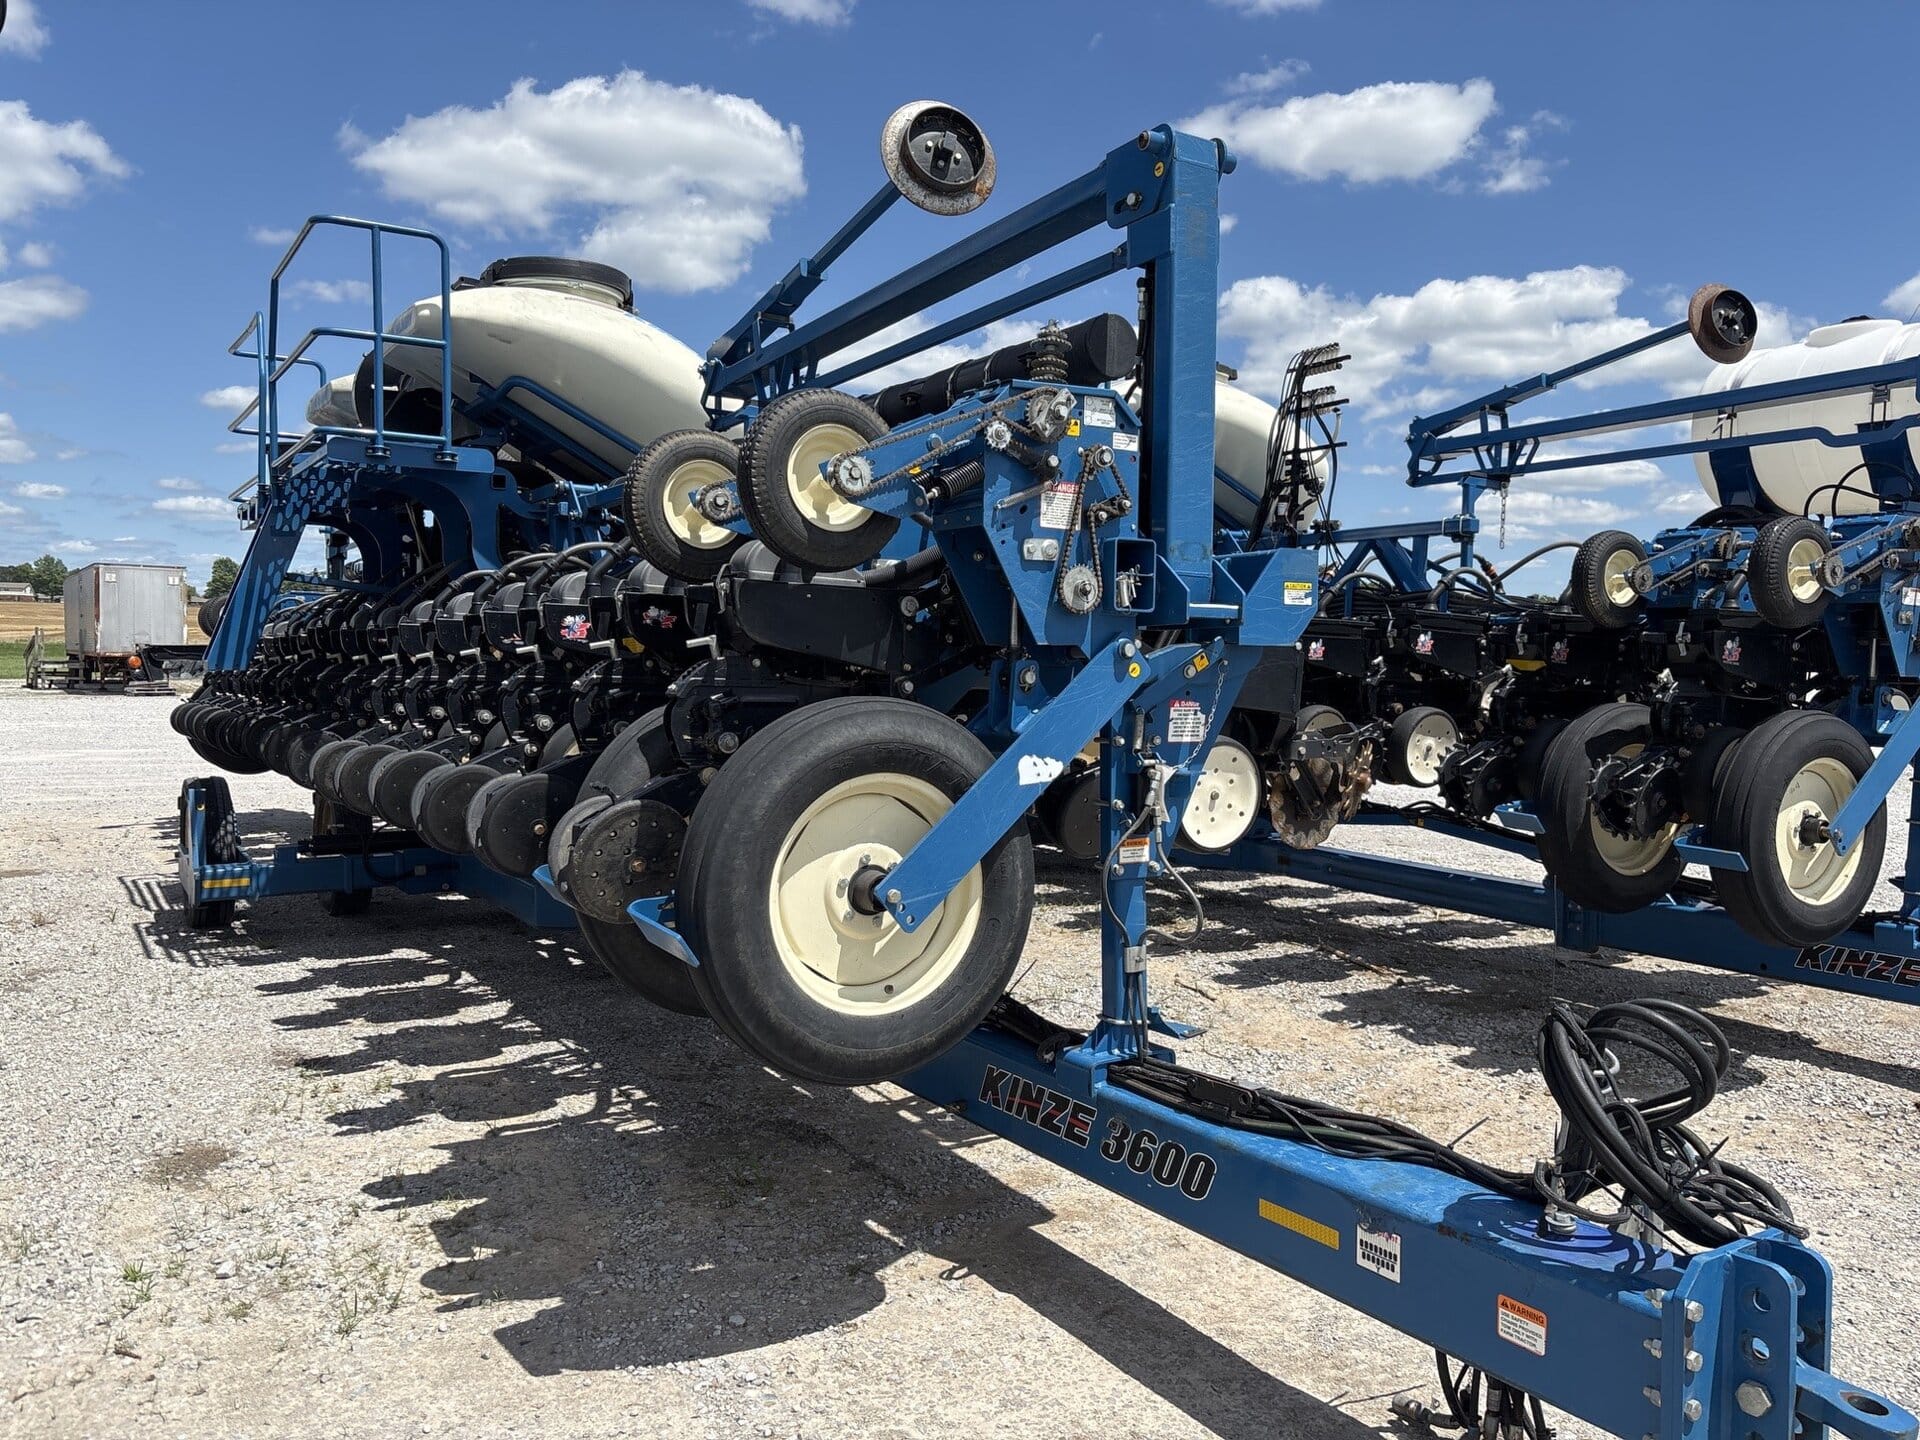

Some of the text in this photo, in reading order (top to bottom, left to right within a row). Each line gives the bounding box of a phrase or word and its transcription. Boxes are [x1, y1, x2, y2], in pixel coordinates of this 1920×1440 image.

[1794, 943, 1920, 988] KINZE
[979, 1064, 1217, 1201] KINZE 3600
[1510, 1301, 1544, 1324] WARNING
